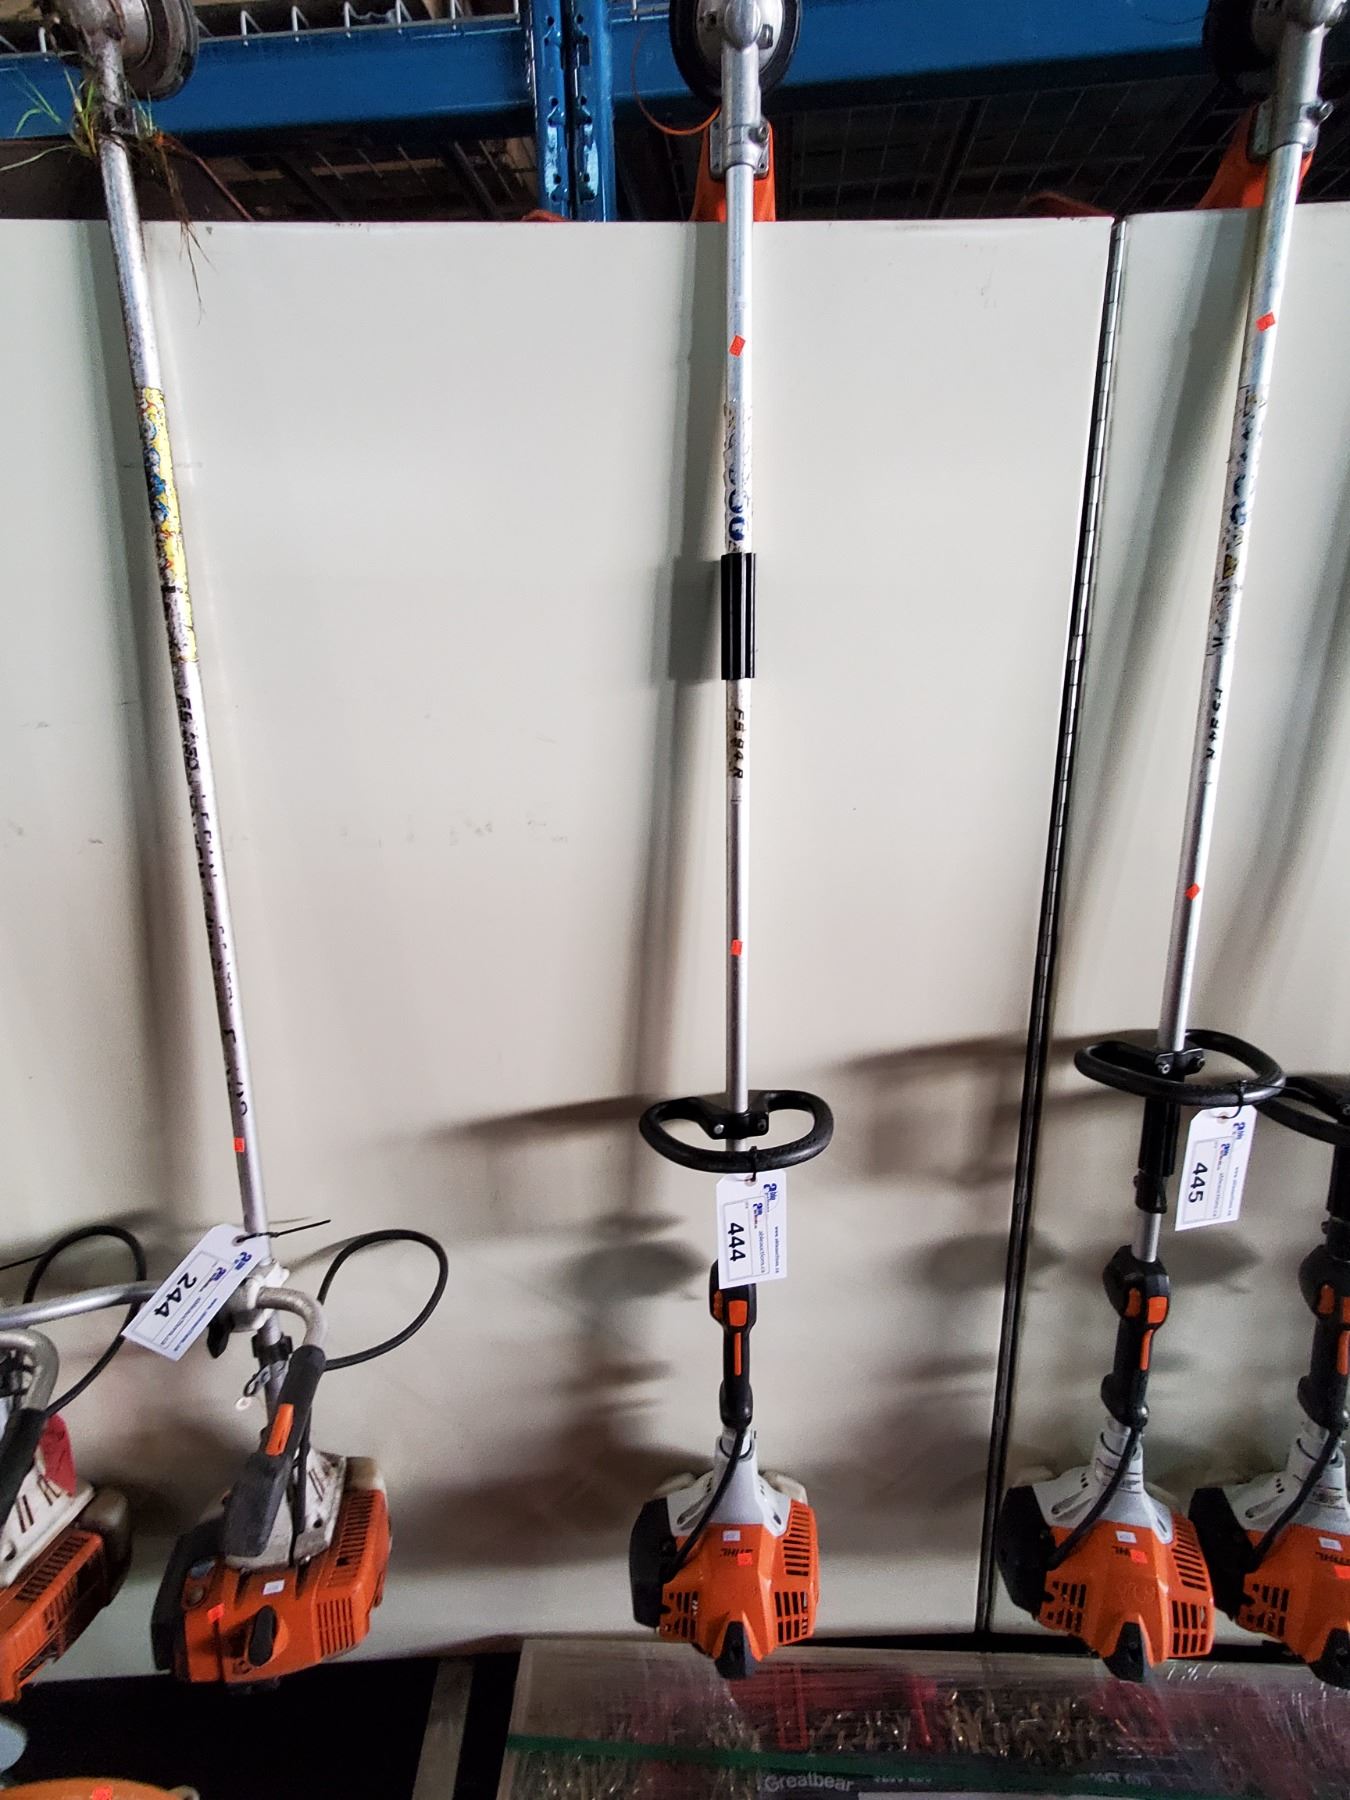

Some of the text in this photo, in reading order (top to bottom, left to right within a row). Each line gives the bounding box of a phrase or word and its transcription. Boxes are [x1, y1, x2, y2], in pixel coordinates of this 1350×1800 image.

[1188, 1161, 1208, 1204] 445
[727, 1222, 746, 1262] 444
[153, 1272, 198, 1318] 244
[764, 1772, 855, 1792] Greatbear
